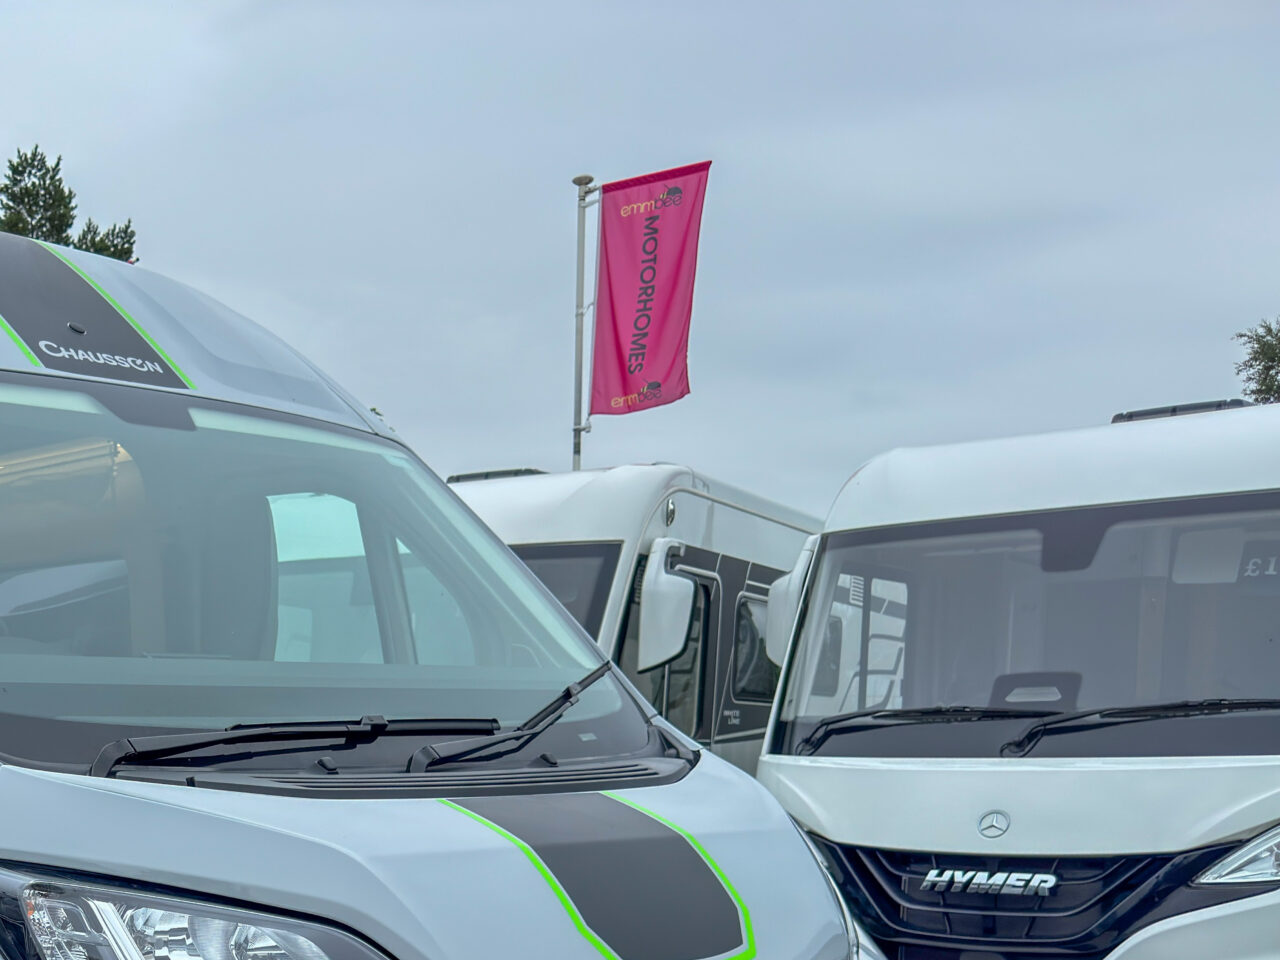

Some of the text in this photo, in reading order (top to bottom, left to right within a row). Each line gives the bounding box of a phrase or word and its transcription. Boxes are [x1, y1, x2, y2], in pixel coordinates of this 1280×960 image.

[620, 190, 683, 217] emmbee
[628, 215, 659, 375] MOTORHOMES
[920, 868, 1058, 897] HYMER
